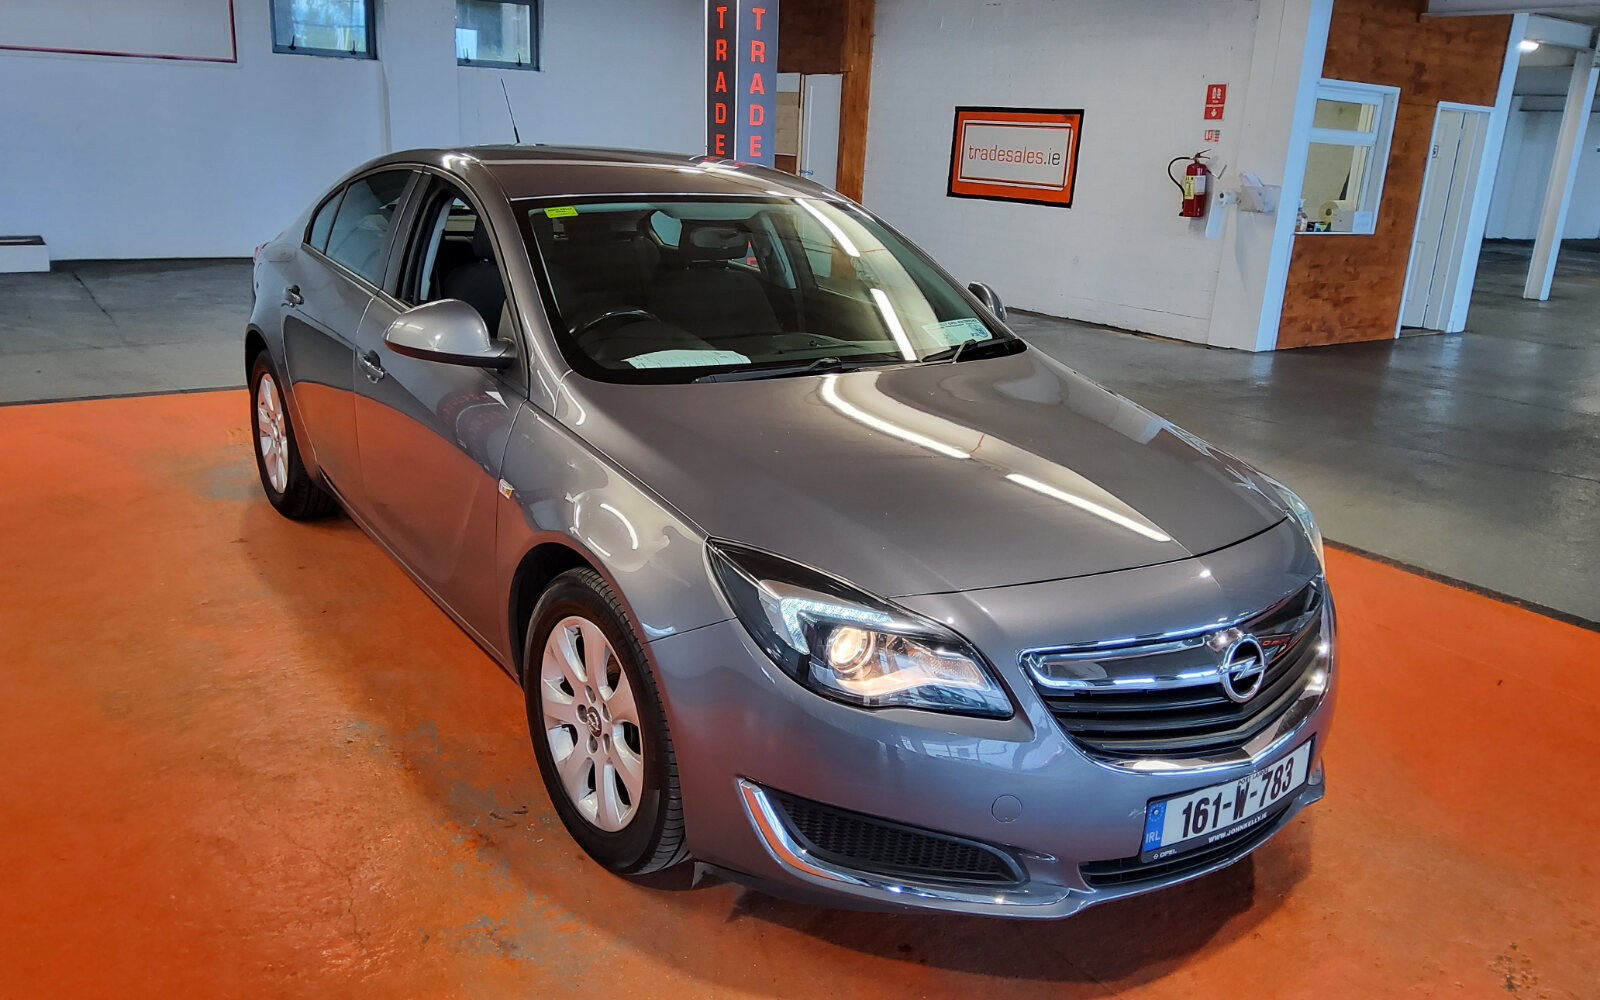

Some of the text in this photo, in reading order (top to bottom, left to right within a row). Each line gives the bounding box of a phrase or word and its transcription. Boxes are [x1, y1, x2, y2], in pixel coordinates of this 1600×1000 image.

[715, 7, 727, 155] TRADE
[749, 7, 766, 157] TRADE
[969, 145, 1060, 165] tradesales.ie
[1182, 757, 1295, 839] 161-W-783
[1146, 832, 1161, 843] IRL
[1160, 849, 1177, 858] OPEL
